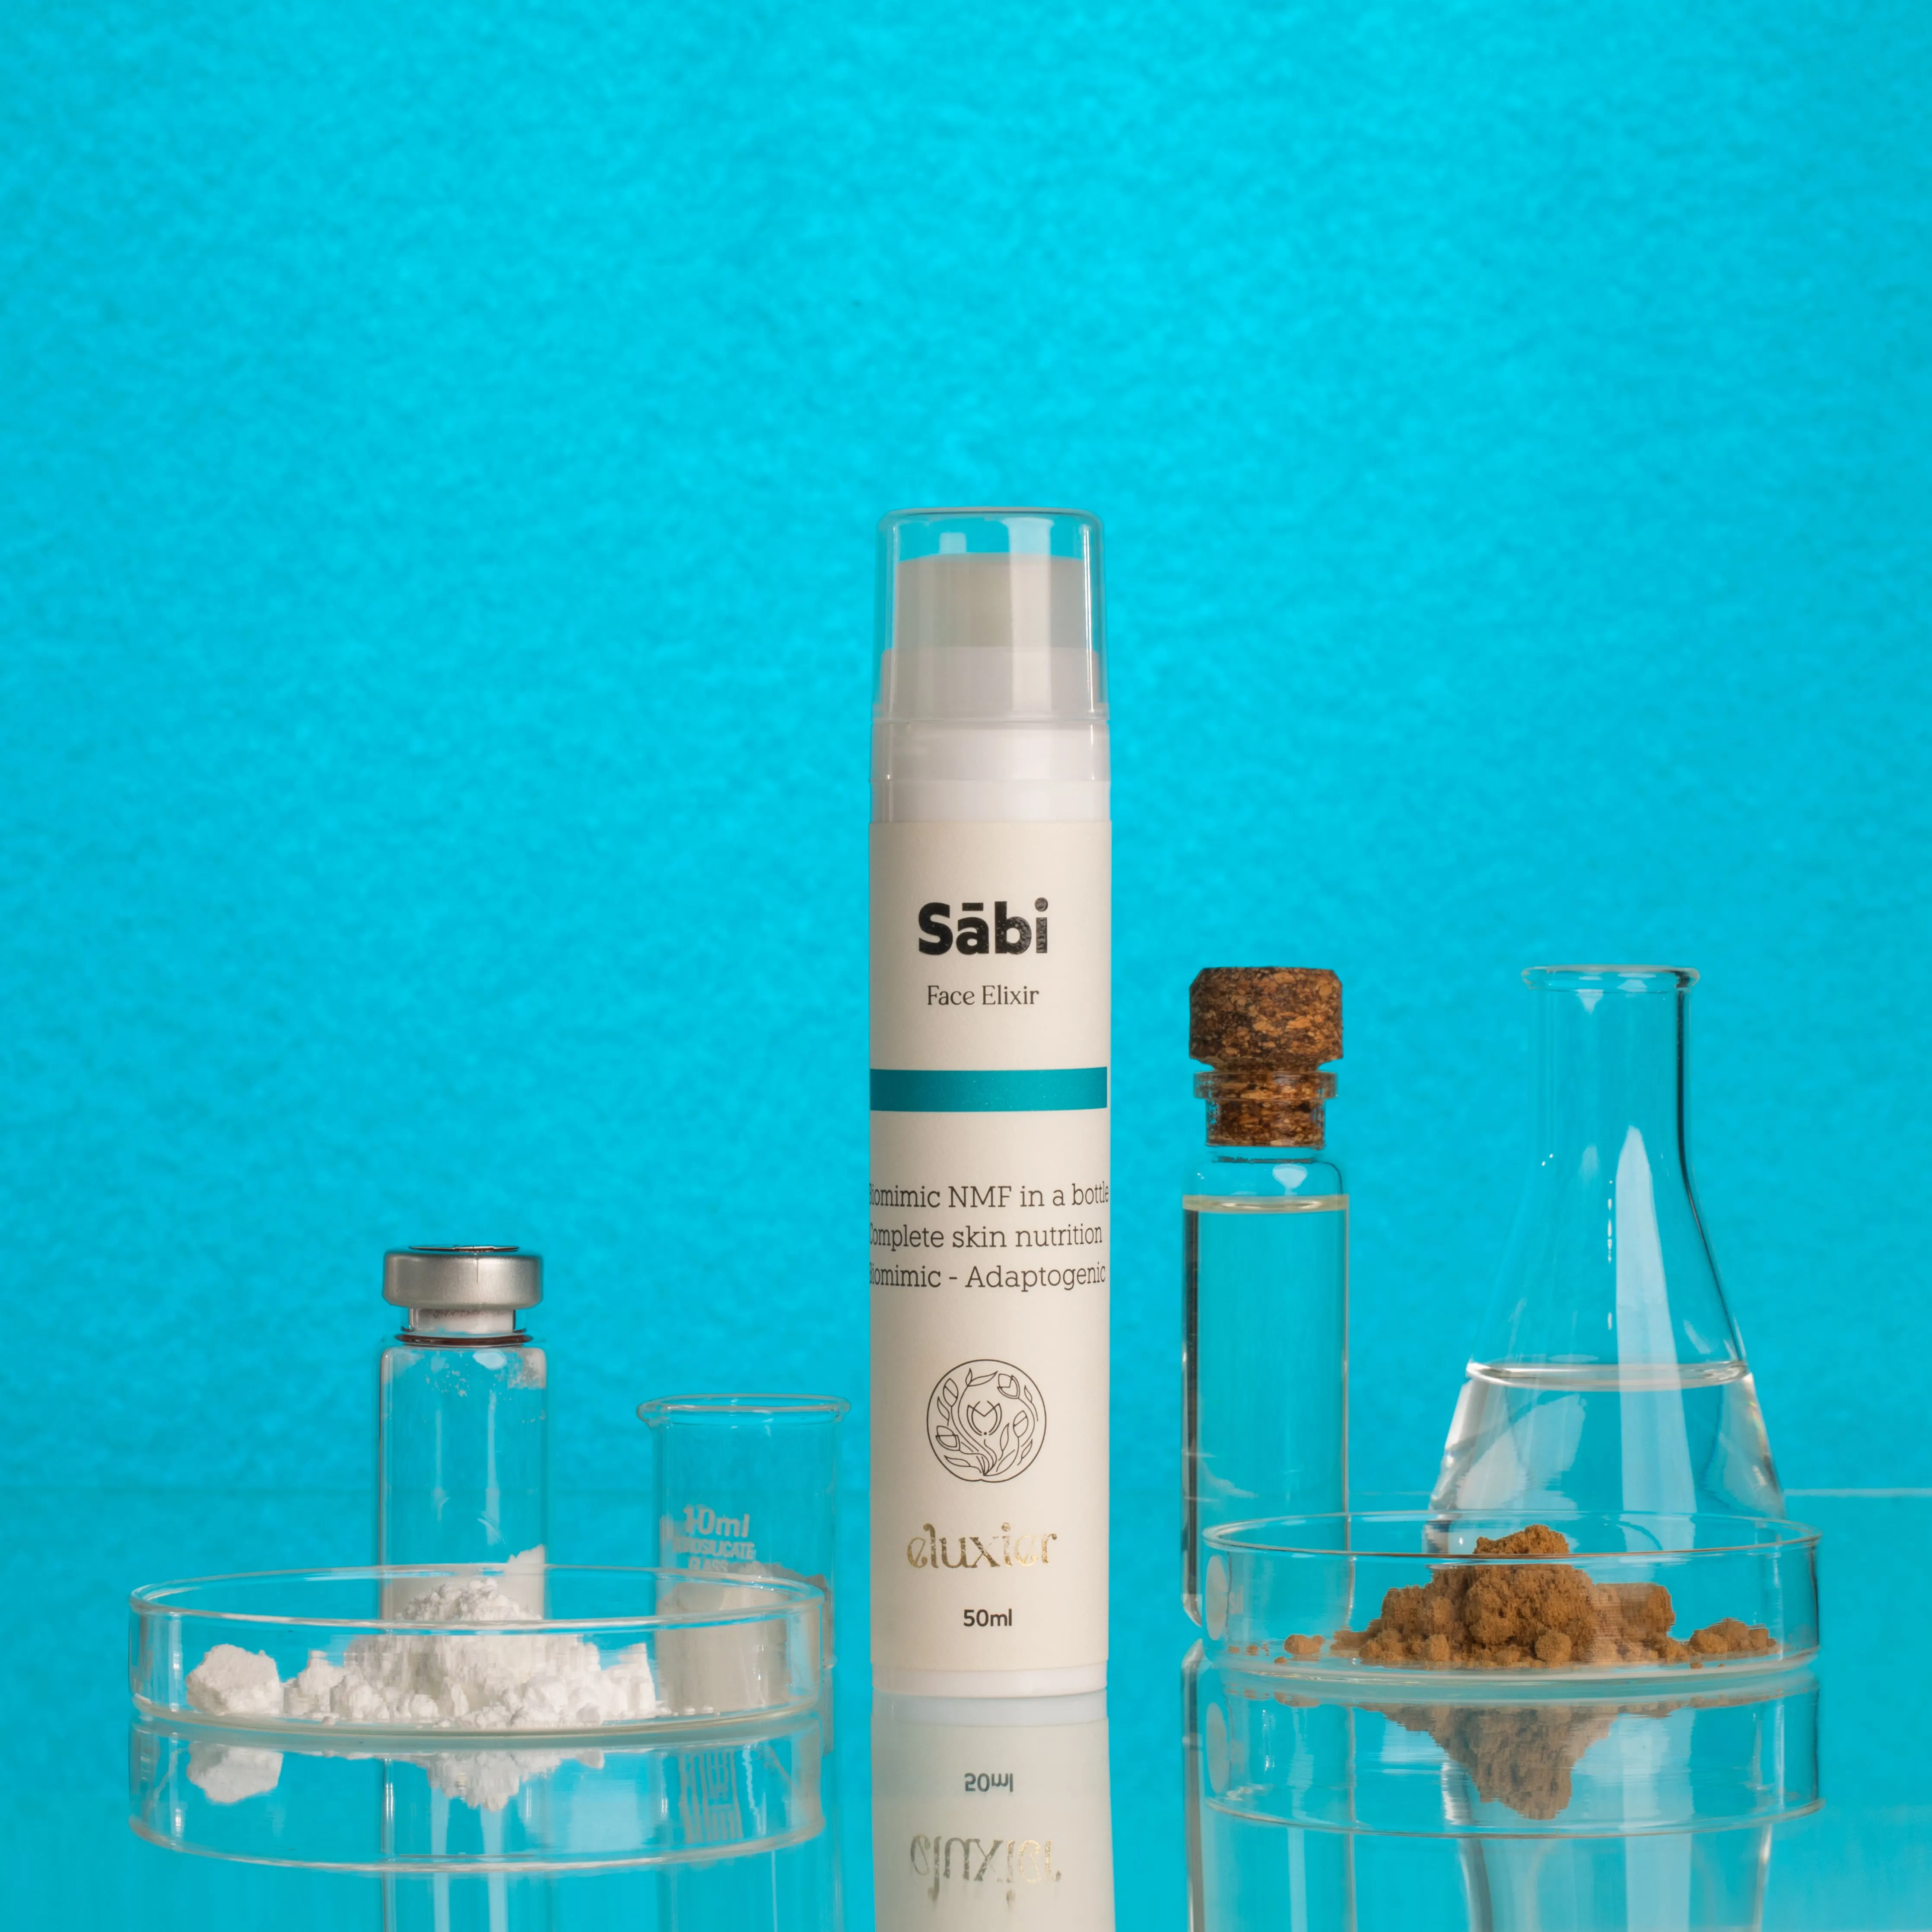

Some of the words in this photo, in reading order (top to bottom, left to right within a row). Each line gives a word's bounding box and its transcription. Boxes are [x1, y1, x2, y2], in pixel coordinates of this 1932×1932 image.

[918, 897, 1049, 956] Sābi
[927, 985, 975, 1006] Face
[981, 984, 1040, 1006] Elixir
[948, 1185, 1012, 1208] NMF
[1020, 1185, 1045, 1208] in
[1052, 1189, 1066, 1207] a
[1071, 1180, 1109, 1206] bottle
[952, 1225, 1007, 1248] skin
[1015, 1223, 1103, 1248] nutrition
[964, 1261, 1106, 1293] Adaptogenic
[683, 1503, 750, 1538] 10ml
[907, 1522, 1058, 1569] eluxier
[963, 1608, 1013, 1627] 50ml
